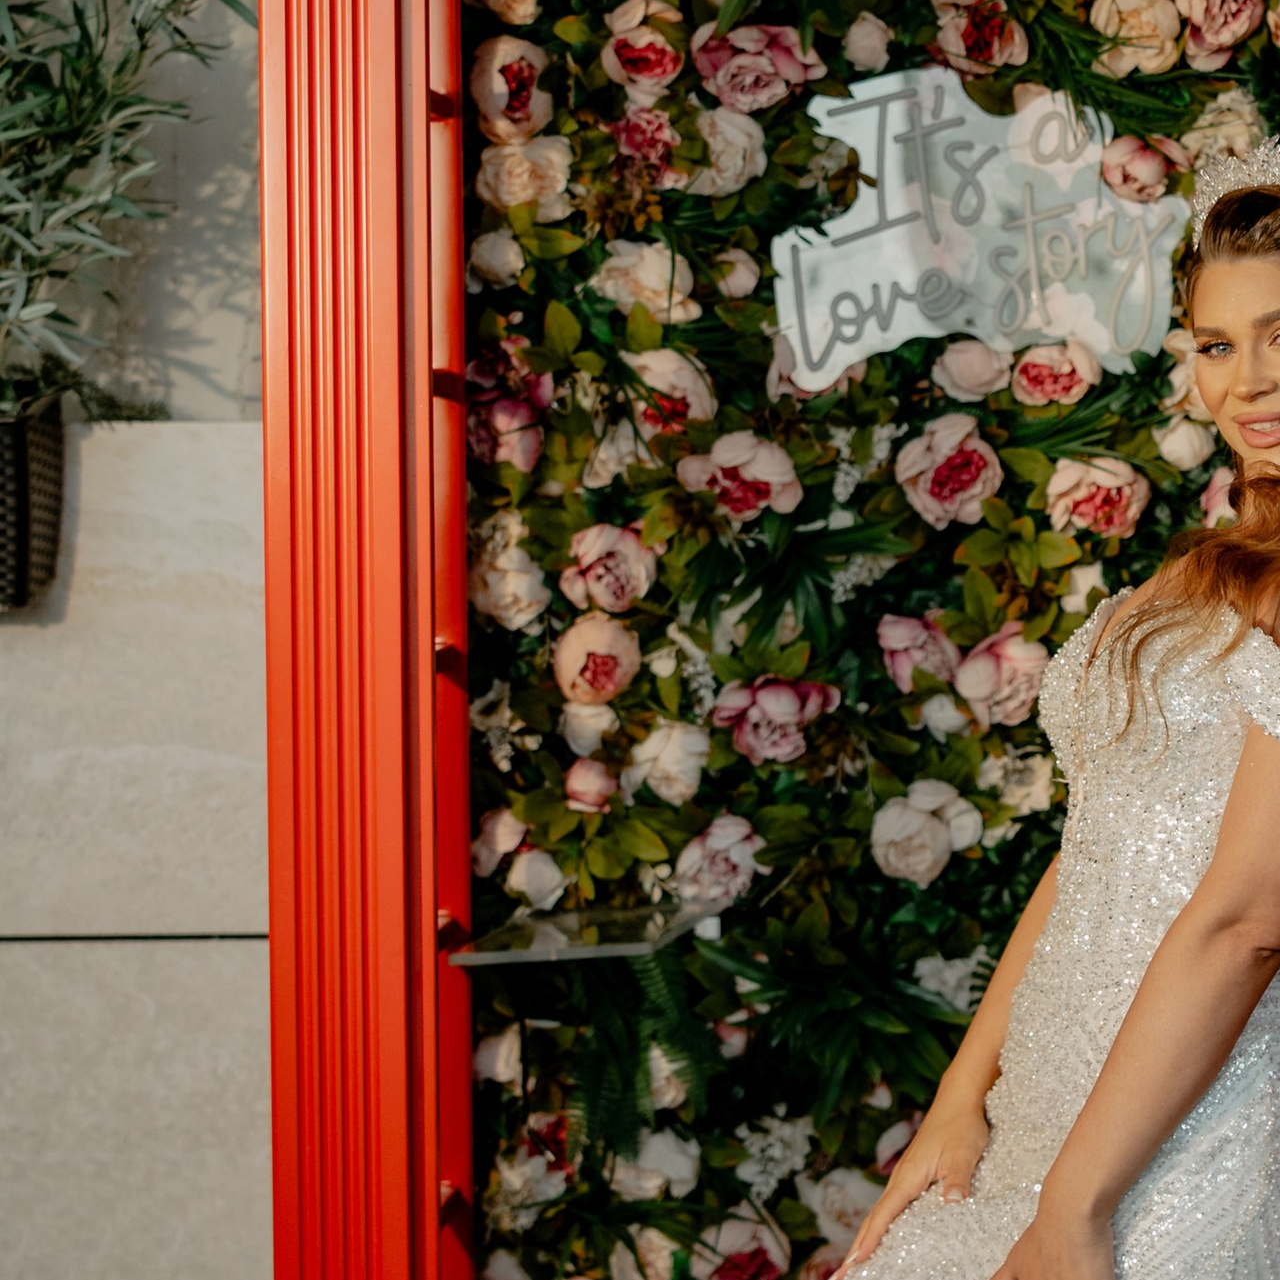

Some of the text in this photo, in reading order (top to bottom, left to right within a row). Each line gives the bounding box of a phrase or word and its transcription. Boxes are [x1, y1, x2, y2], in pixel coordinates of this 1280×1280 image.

[826, 83, 1096, 246] It's a
[988, 181, 1177, 355] story
